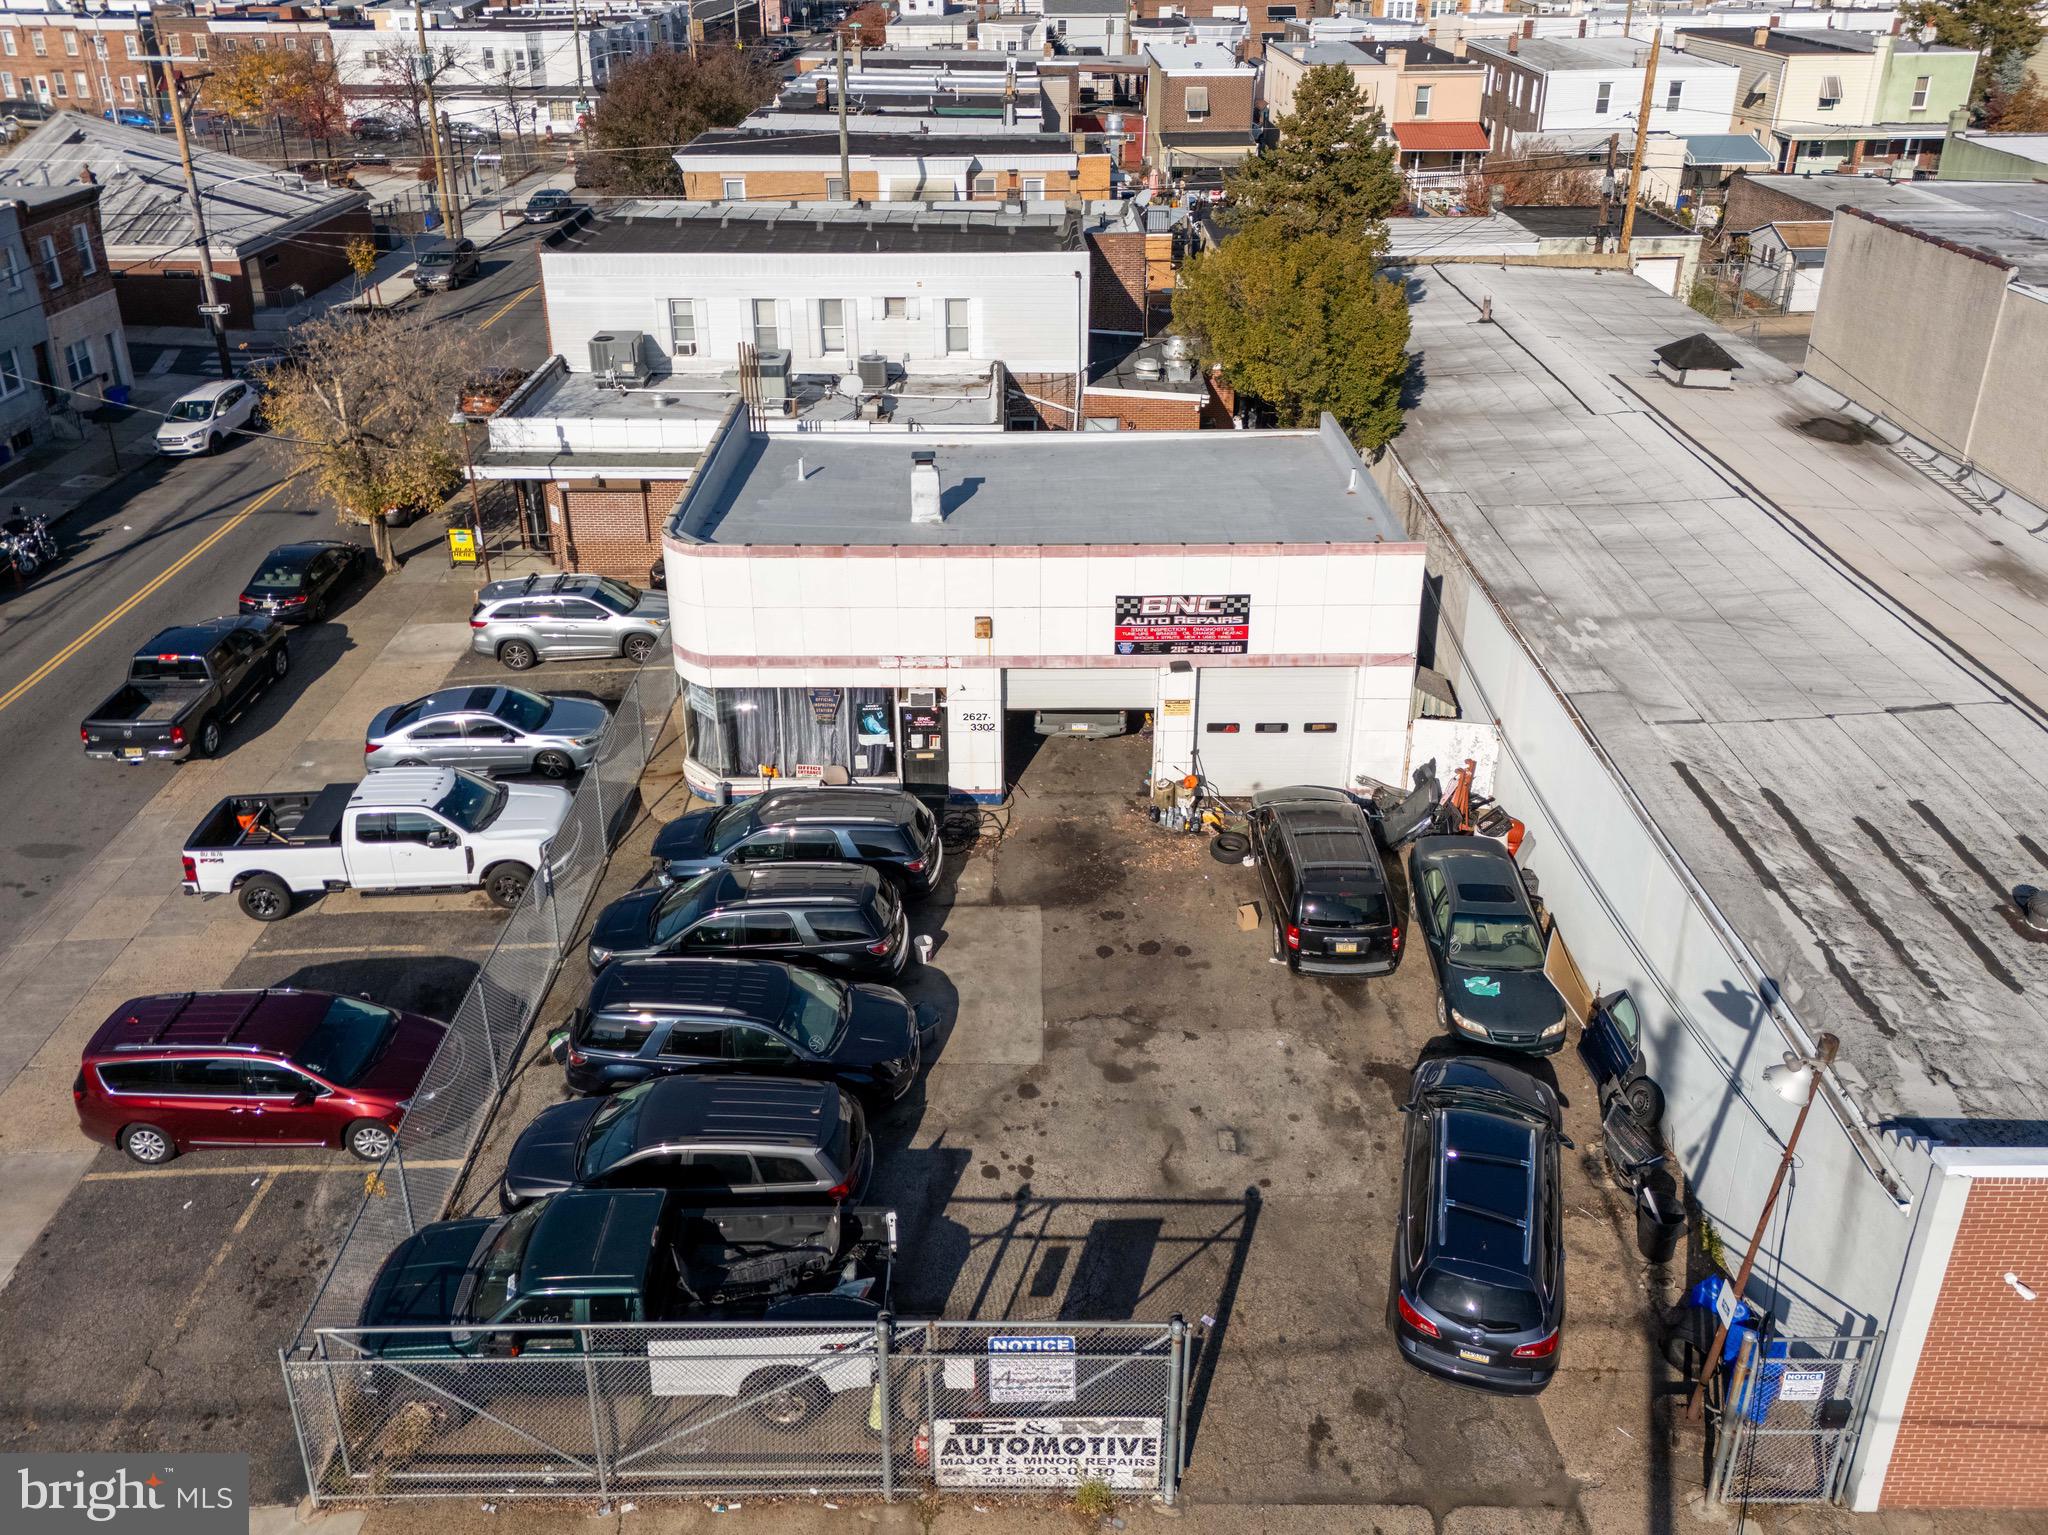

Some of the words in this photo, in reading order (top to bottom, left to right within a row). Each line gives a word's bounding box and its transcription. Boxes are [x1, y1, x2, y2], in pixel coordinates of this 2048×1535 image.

[1140, 596, 1227, 615] BNC
[1170, 645, 1242, 653] 215-634-1100
[970, 723, 996, 731] 3302
[993, 1340, 1070, 1351] NOTICE
[1021, 1420, 1052, 1435] &
[941, 1437, 1158, 1456] AUTOMOTIVE
[940, 1457, 999, 1465] MAJOR
[1005, 1457, 1017, 1465] &
[1023, 1457, 1079, 1465] MINOR
[1085, 1457, 1156, 1466] REPAIRS
[981, 1467, 1115, 1476] 215-203-0130
